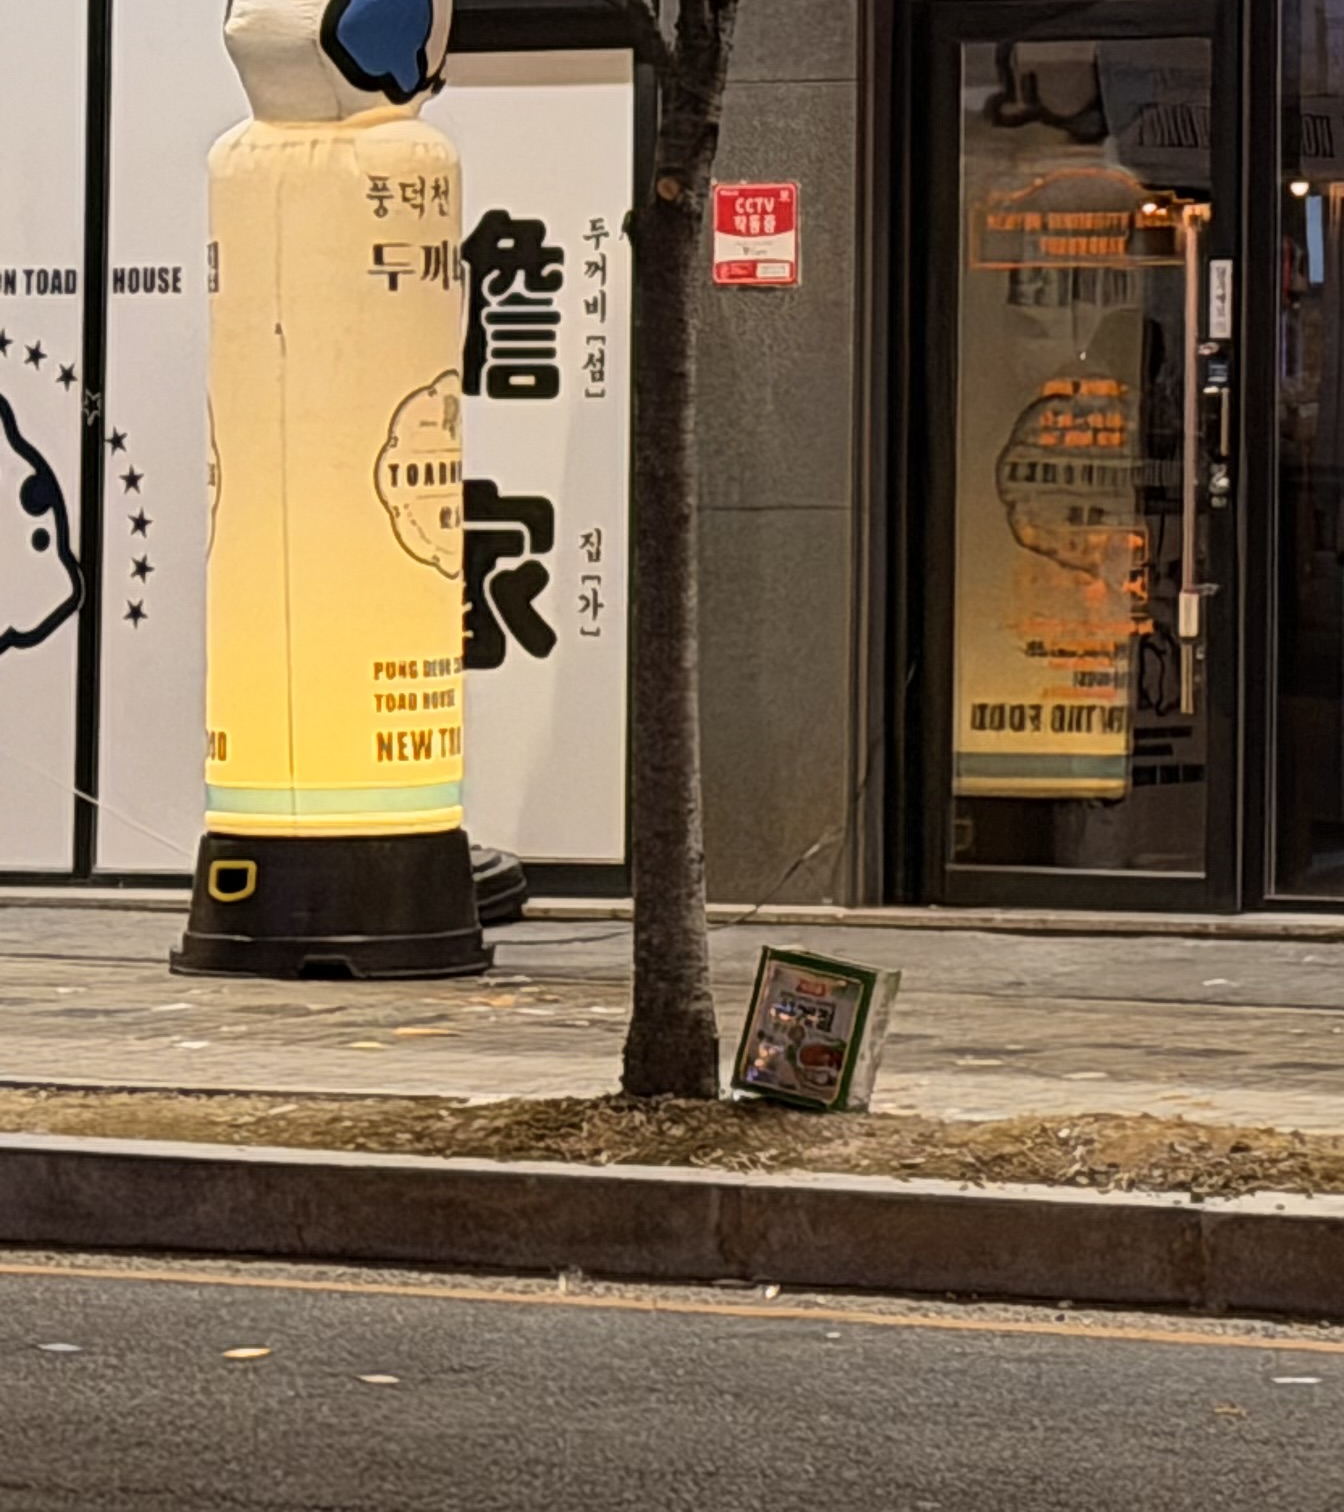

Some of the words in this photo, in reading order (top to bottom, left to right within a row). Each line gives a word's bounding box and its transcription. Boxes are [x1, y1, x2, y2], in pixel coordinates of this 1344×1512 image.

[366, 174, 450, 219] 풍덕천
[734, 196, 776, 215] CCTV
[24, 268, 77, 295] TOAD
[112, 266, 183, 295] HOUSE
[582, 218, 610, 324] 두꺼비
[578, 527, 603, 564] 집
[373, 693, 418, 713] TOAD
[376, 729, 434, 763] NEW
